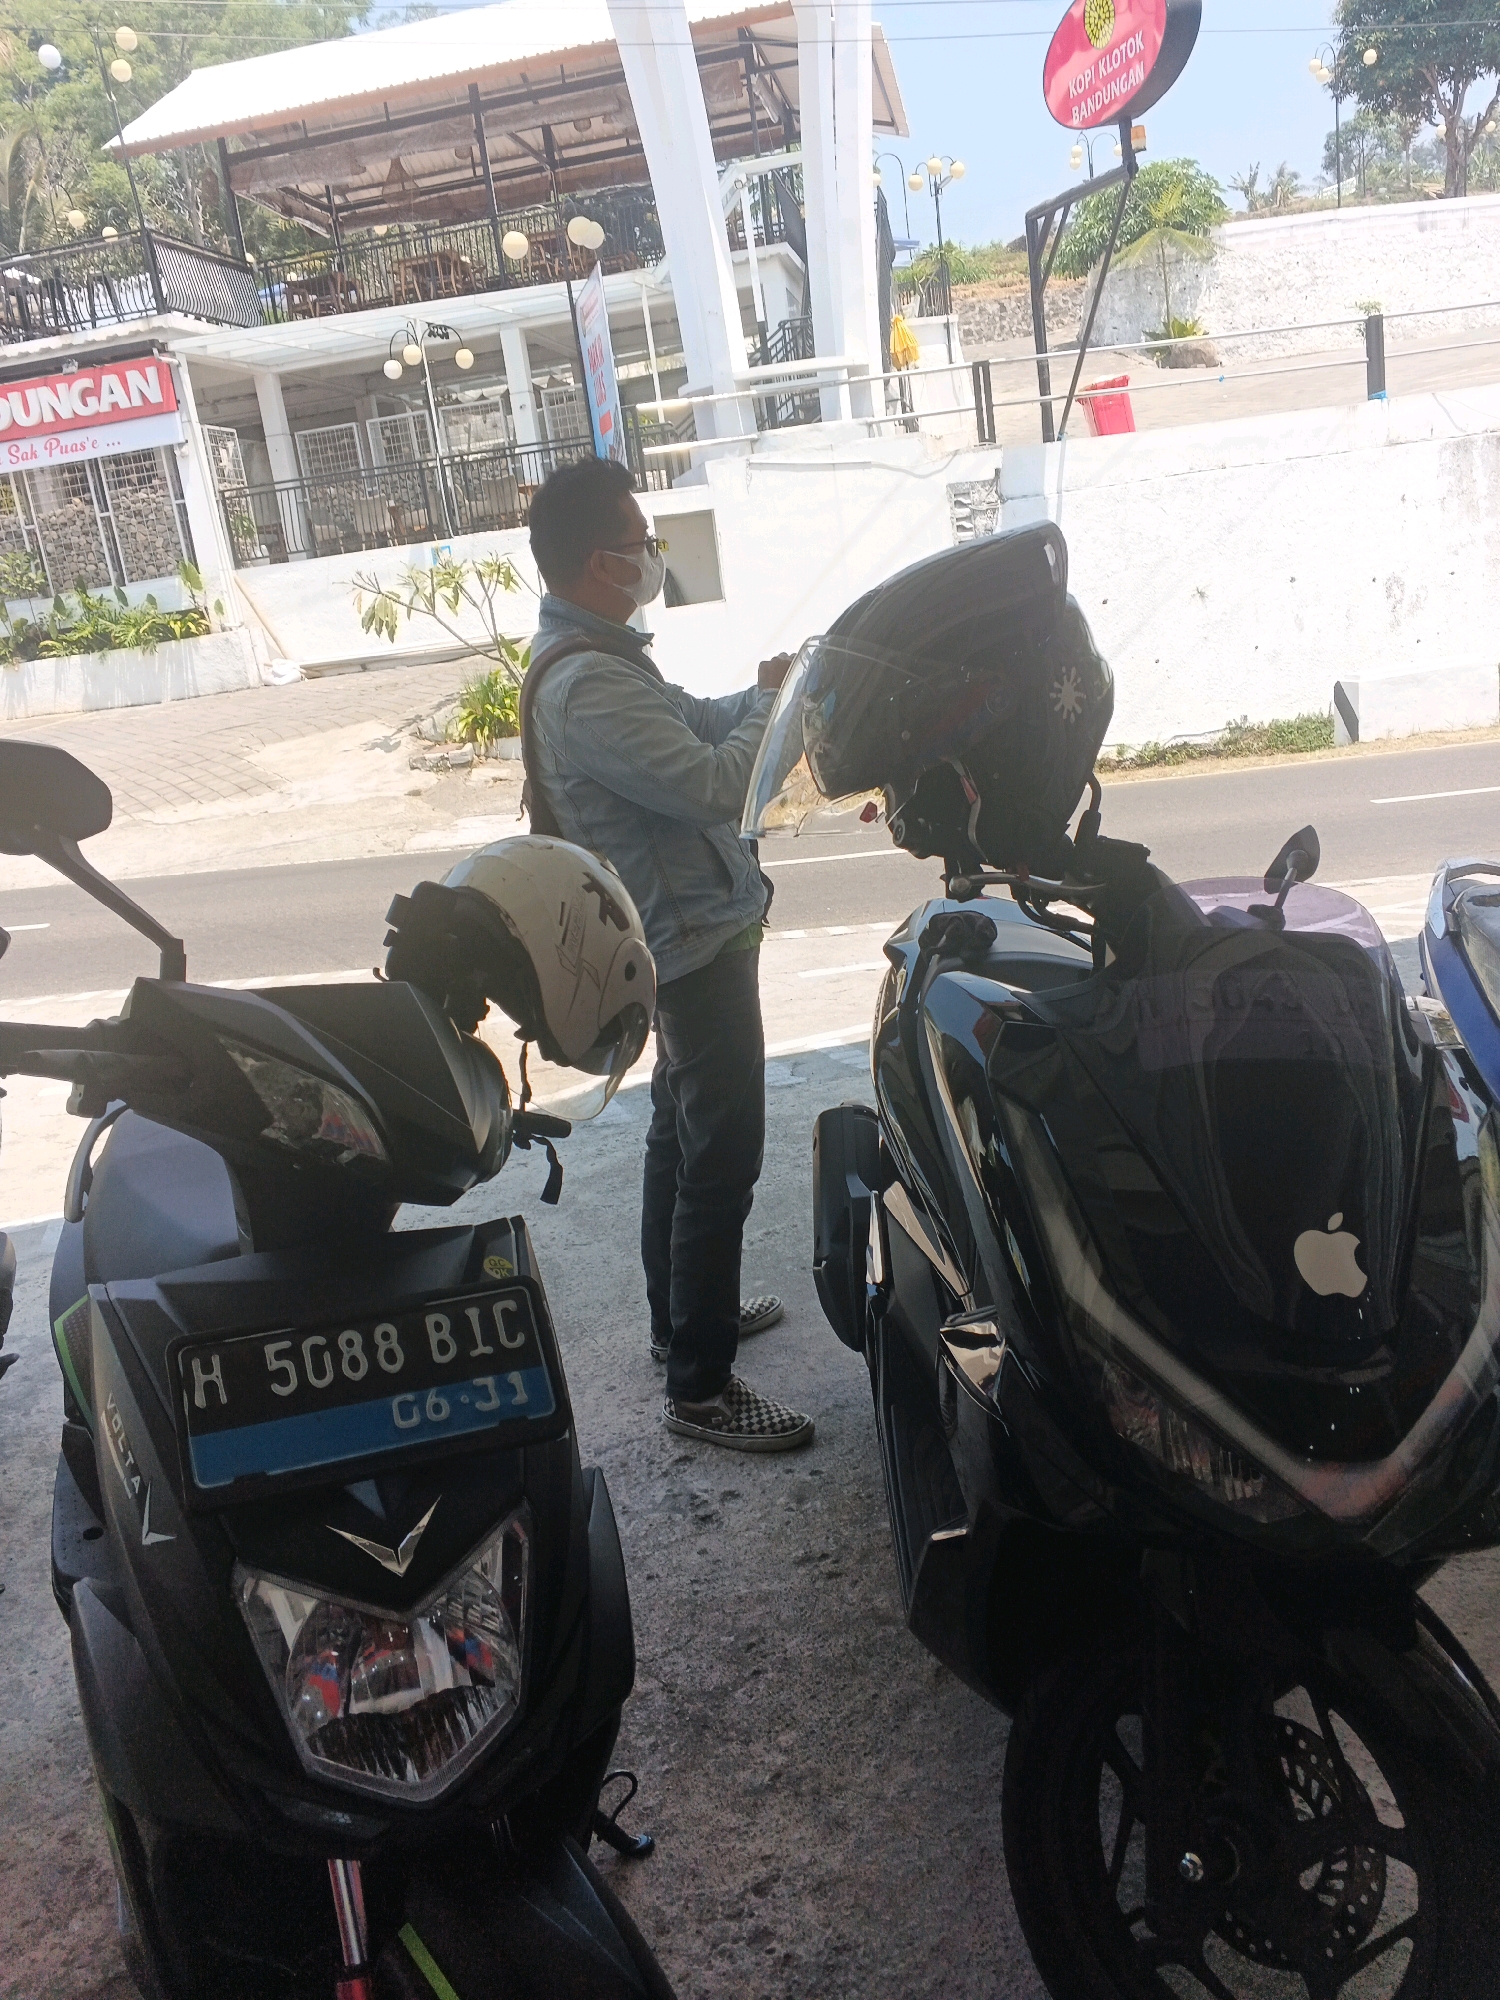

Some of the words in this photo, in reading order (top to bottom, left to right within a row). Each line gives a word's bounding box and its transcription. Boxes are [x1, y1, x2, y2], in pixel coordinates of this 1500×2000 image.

[1068, 66, 1096, 99] KOPI
[1098, 30, 1145, 79] KLOTOK
[1071, 61, 1145, 125] BANDUNGAN
[8, 444, 39, 464] Sak
[192, 1354, 227, 1408] H
[264, 1323, 404, 1396] 5088
[425, 1300, 525, 1364] BIC
[106, 1392, 141, 1494] VOLTA
